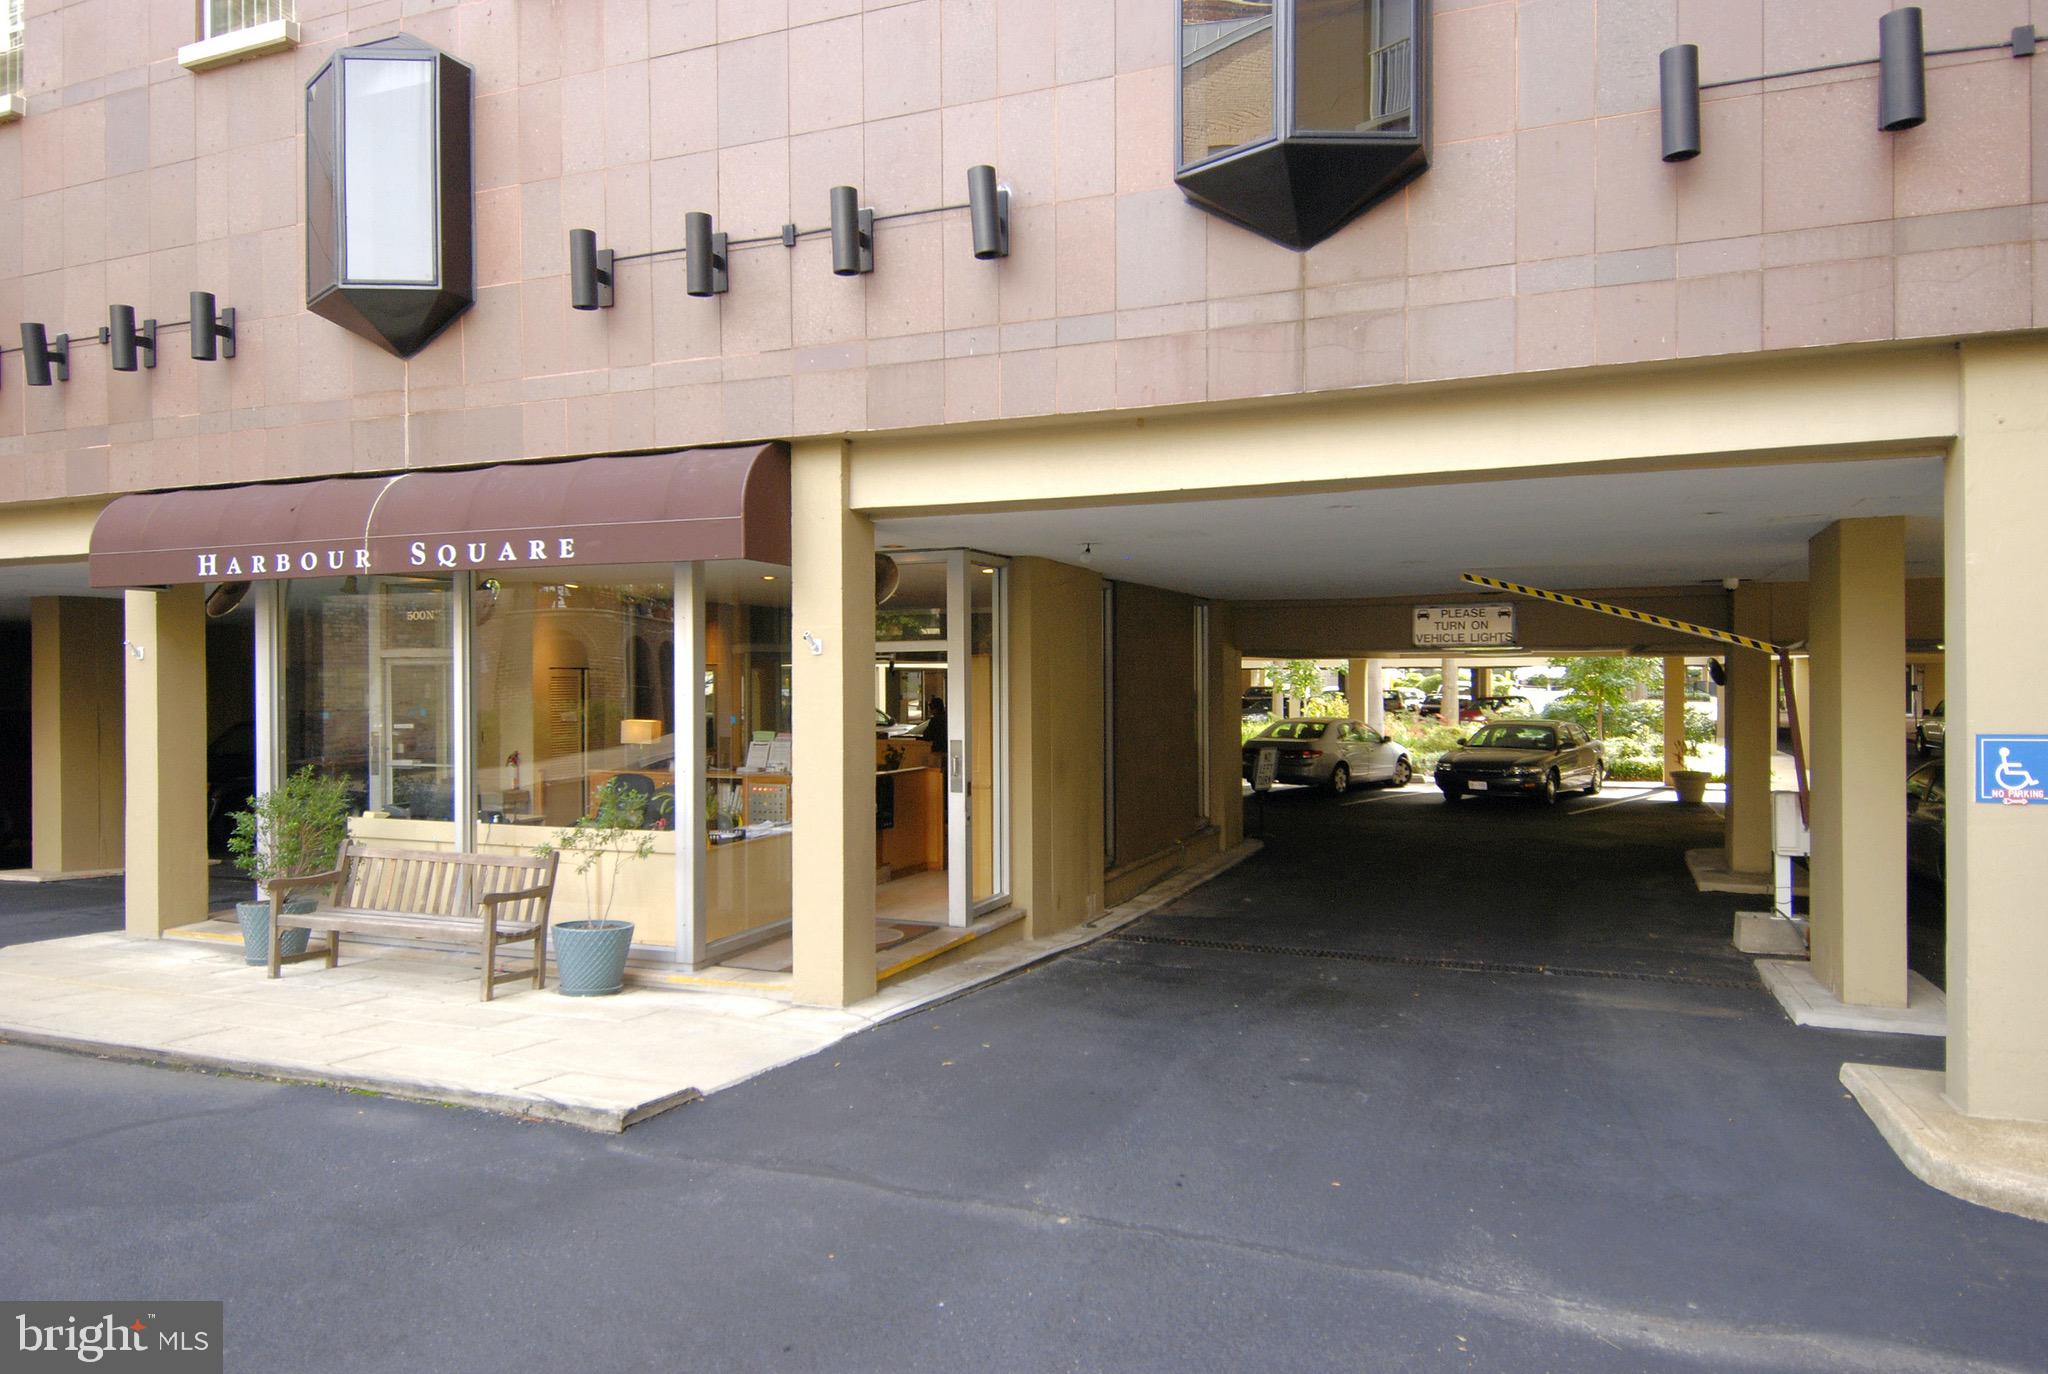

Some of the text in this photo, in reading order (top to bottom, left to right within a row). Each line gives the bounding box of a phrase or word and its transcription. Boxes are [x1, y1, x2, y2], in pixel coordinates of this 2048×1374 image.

[198, 538, 575, 577] HARBOUR SQUARE
[1441, 608, 1487, 618] PLEASE
[1434, 620, 1489, 631] TURN ON
[1416, 632, 1513, 643] VEHICLE LIGHTS
[1991, 789, 2044, 799] NO PARKING
